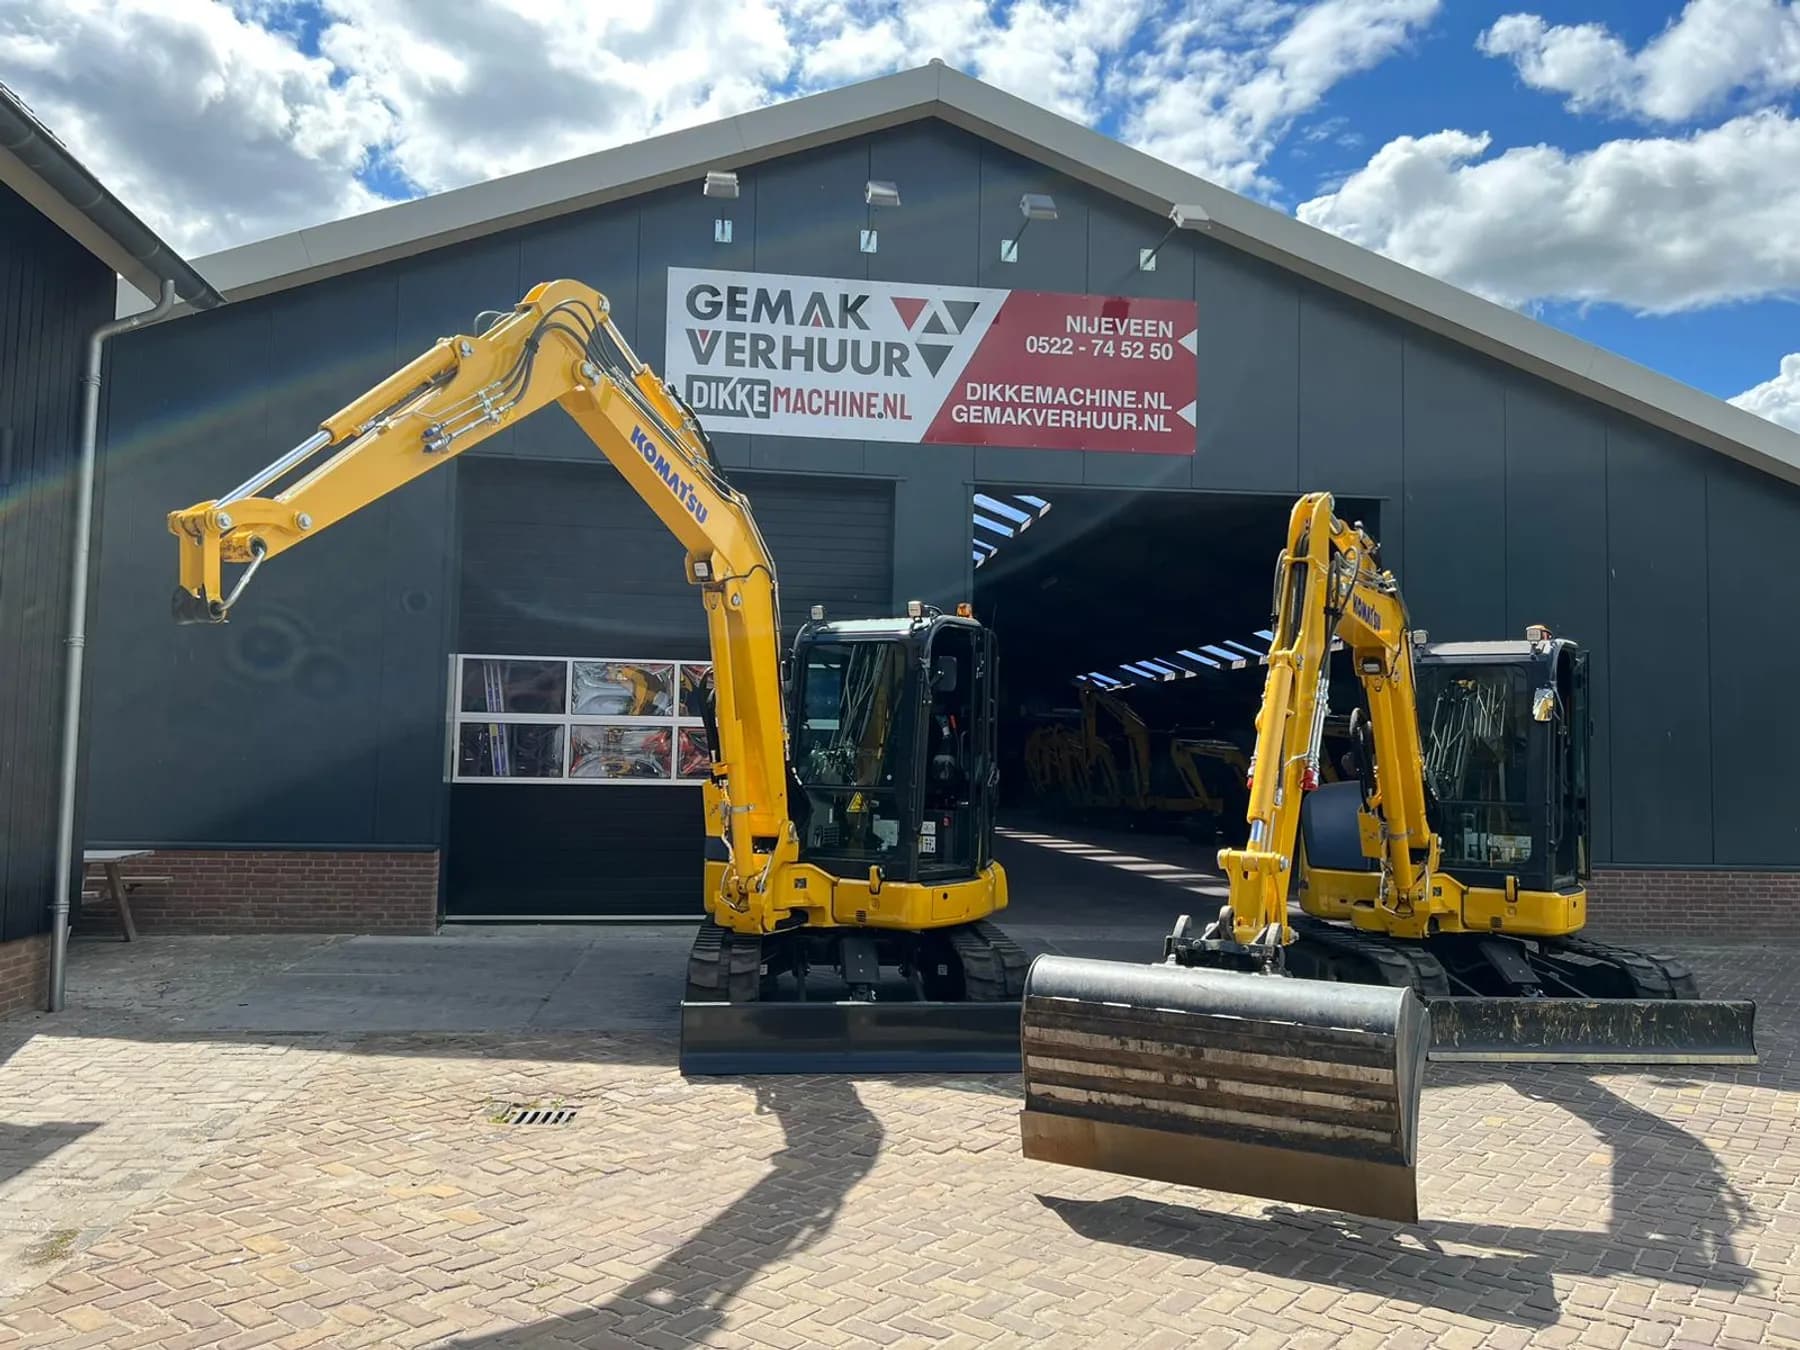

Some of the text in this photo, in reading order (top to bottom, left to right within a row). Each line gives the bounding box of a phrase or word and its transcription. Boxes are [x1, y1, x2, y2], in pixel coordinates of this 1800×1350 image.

[686, 284, 870, 330] GEMAK
[1065, 315, 1173, 338] NIJEVEEN
[686, 329, 912, 377] VERHUUR
[1026, 335, 1073, 355] 0522
[1091, 339, 1115, 357] 74
[1120, 341, 1144, 359] 52
[1149, 343, 1173, 360] 50
[966, 382, 1173, 410] DIKKEMACHINE.NL
[951, 405, 1172, 432] GEMAKVERHUUR.NL
[631, 425, 708, 523] KOMATSU
